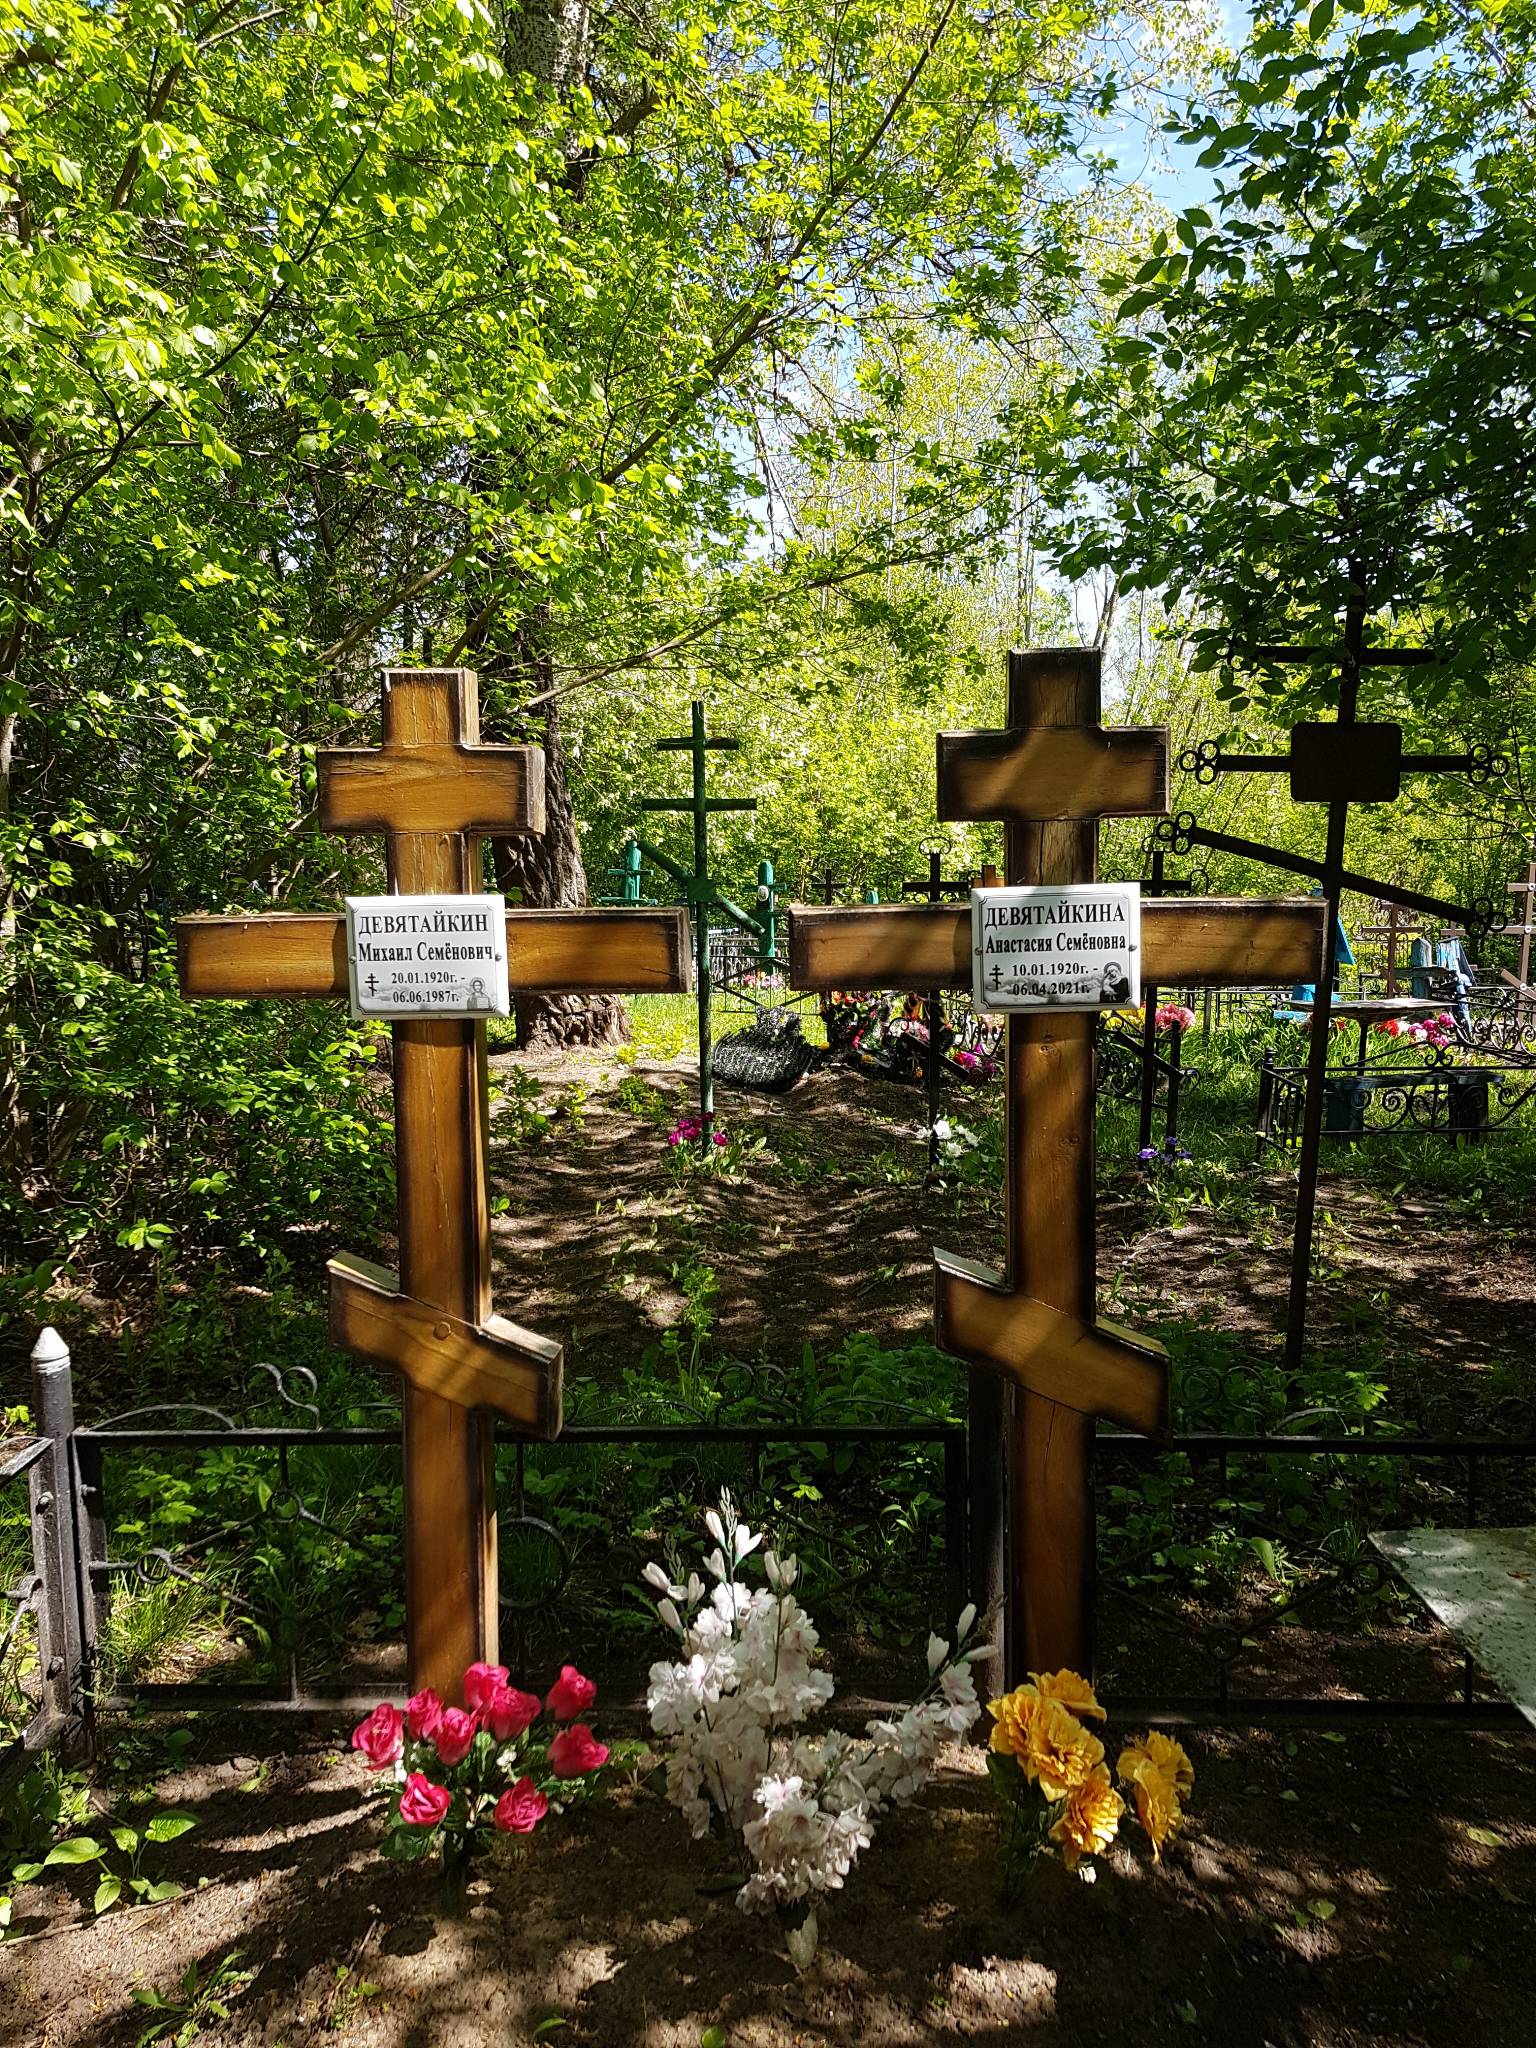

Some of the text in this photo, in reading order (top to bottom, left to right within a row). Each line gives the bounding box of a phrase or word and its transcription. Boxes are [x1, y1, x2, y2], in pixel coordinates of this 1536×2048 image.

[985, 900, 1125, 930] ДЕВЯТАЙКИНА
[358, 910, 488, 938] ДЕВЯТАЙКИН
[986, 932, 1126, 953] Анастасия Семёновна
[358, 942, 492, 961] Михаил Семёнович
[1012, 963, 1089, 976] 10.01.1920г.
[392, 972, 458, 984] 20.01.1920г.
[393, 991, 459, 1003] 06.06.1987г.
[1012, 983, 1090, 995] 06.04.2021г.
